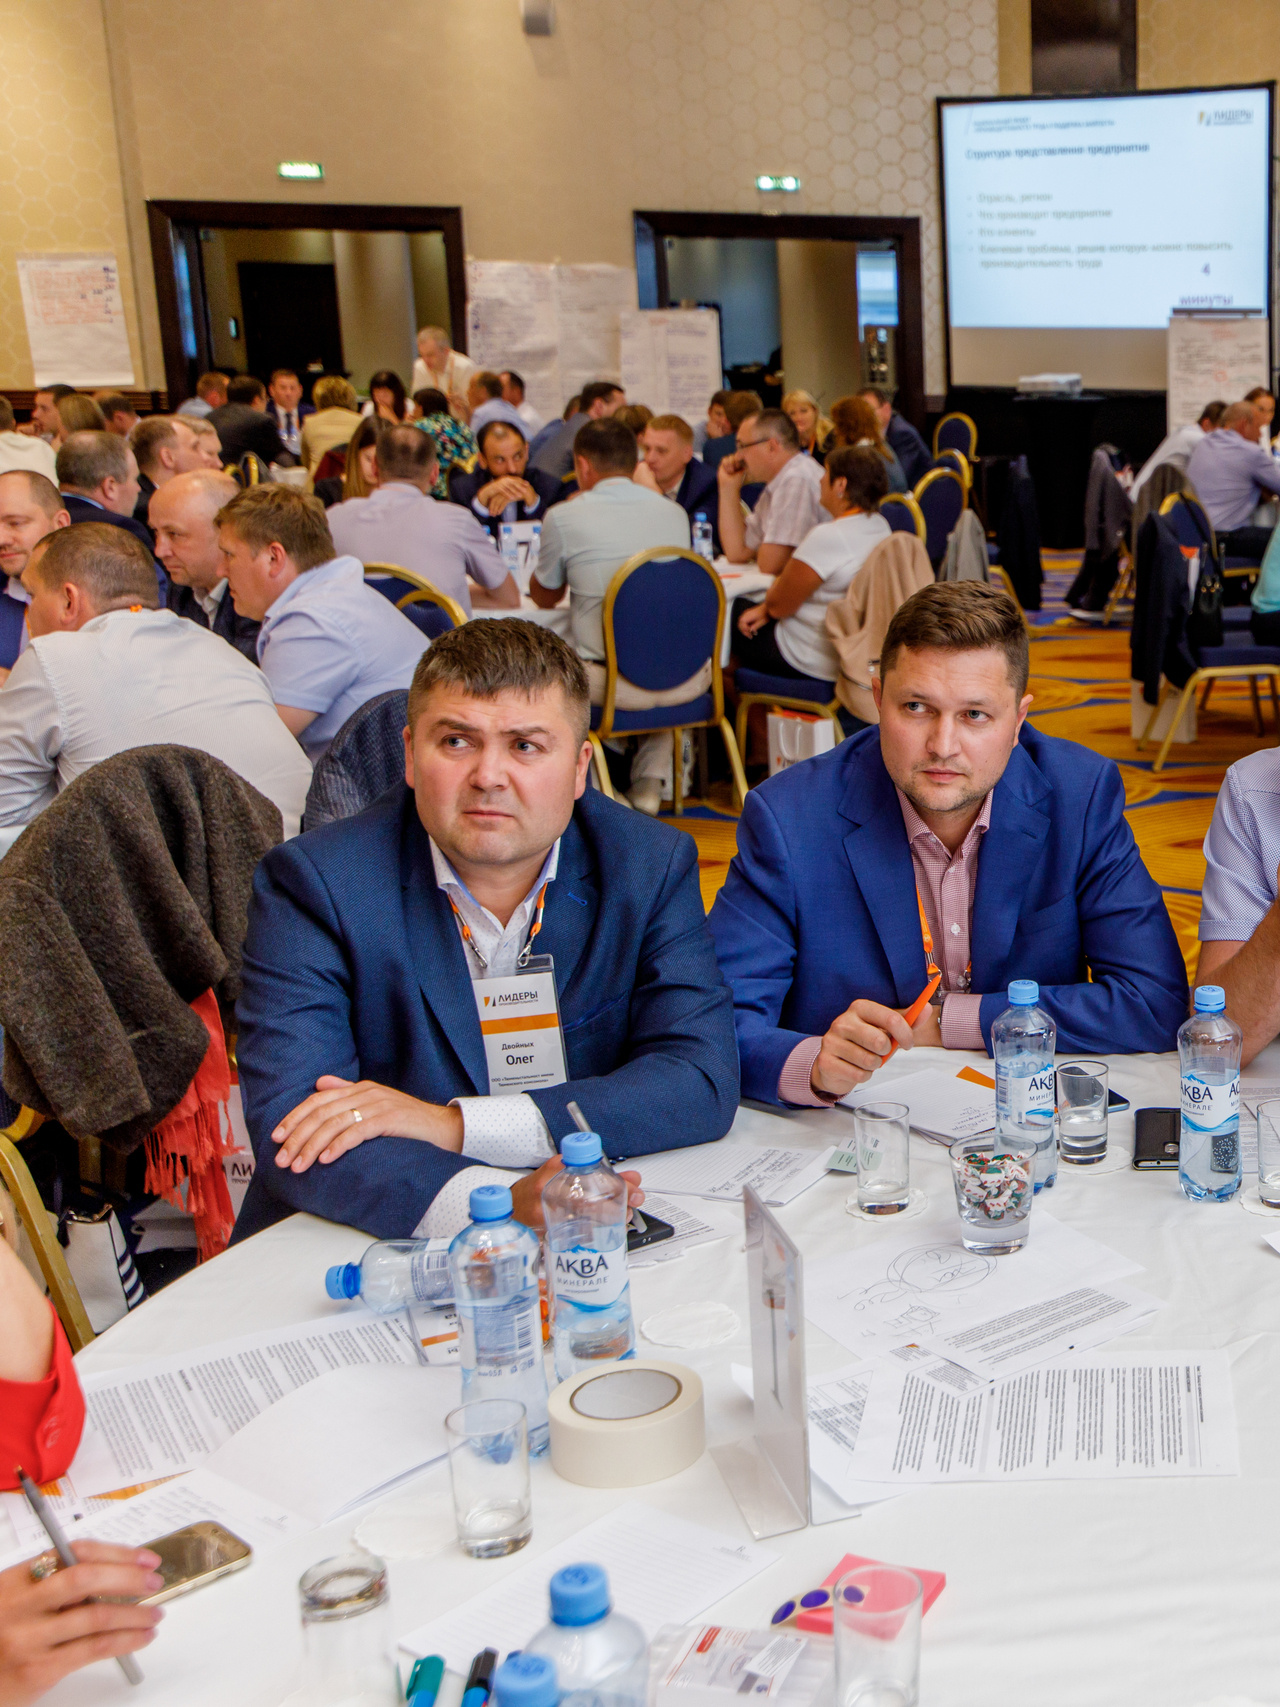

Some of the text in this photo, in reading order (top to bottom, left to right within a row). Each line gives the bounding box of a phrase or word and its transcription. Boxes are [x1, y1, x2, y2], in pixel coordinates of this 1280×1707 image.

[498, 990, 538, 1003] ЛИДЕРЫ
[502, 1041, 534, 1051] Двойных
[506, 1055, 535, 1066] Олег
[1028, 1073, 1053, 1091] АКВ
[556, 1254, 609, 1278] АКВА
